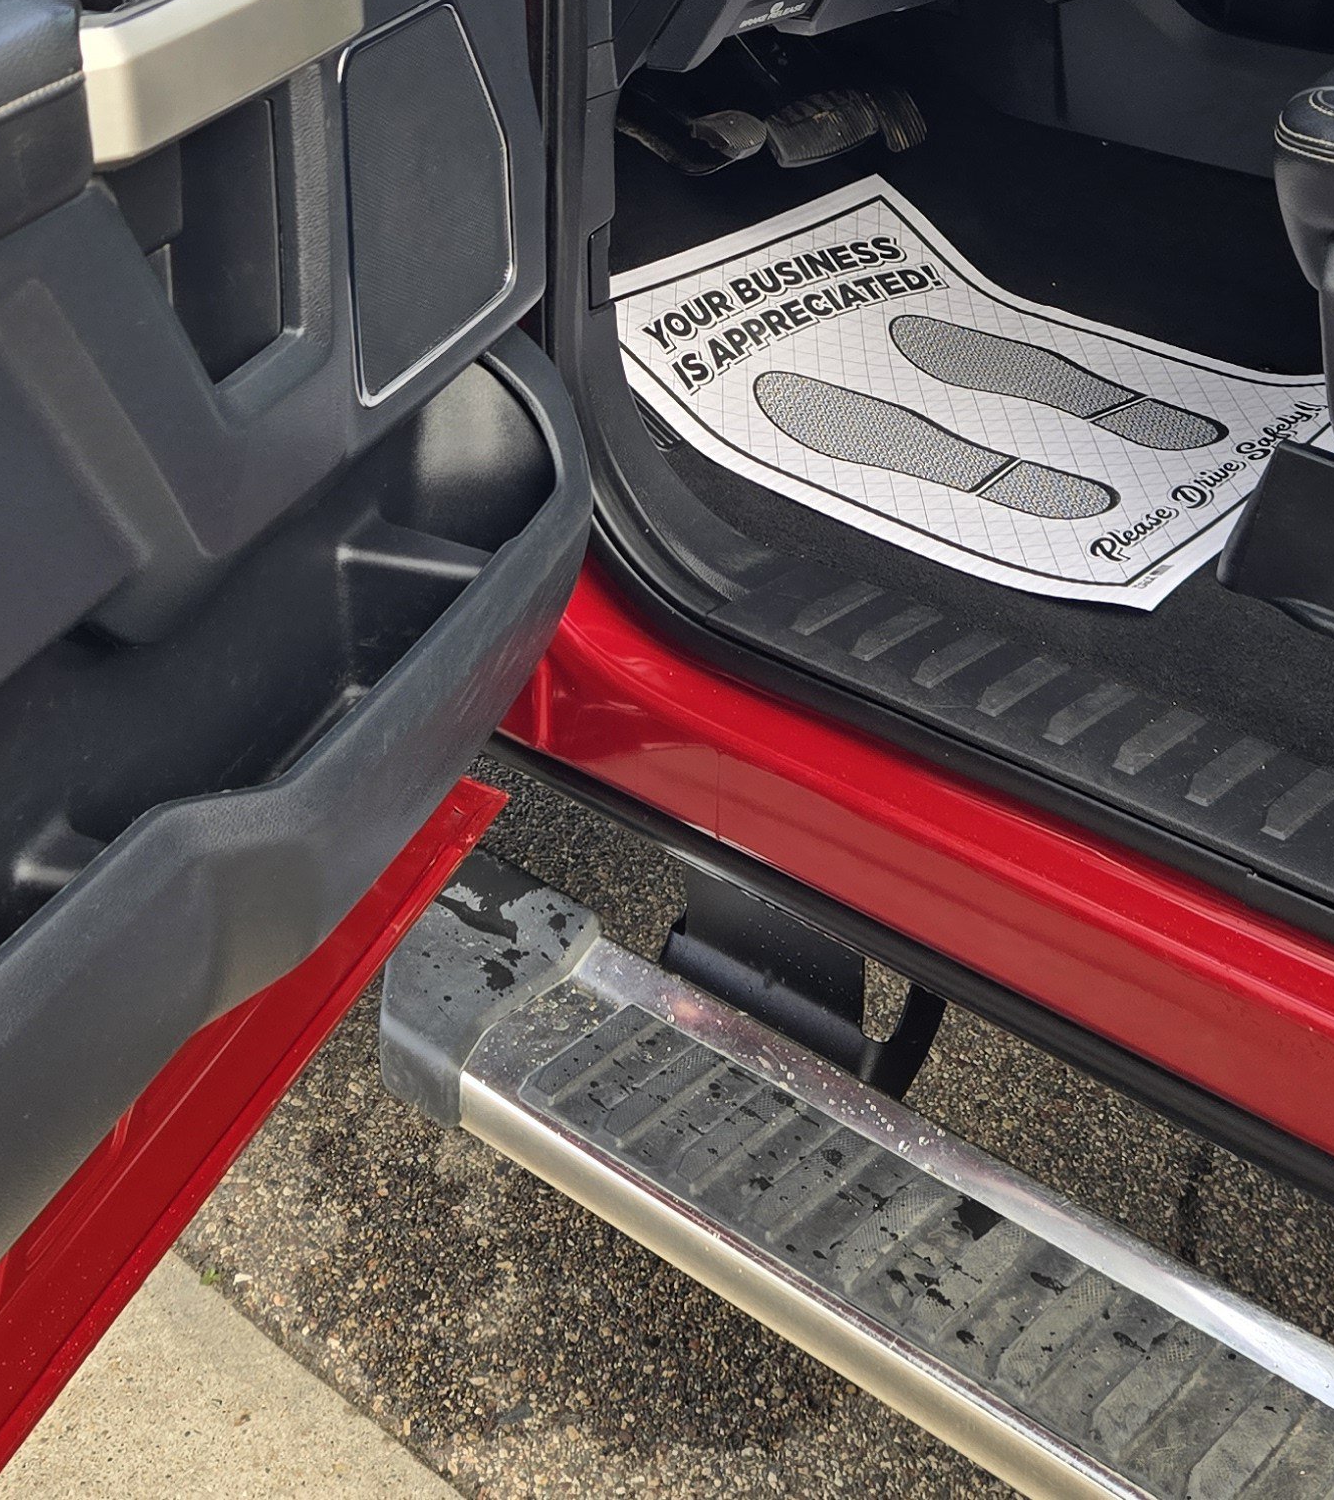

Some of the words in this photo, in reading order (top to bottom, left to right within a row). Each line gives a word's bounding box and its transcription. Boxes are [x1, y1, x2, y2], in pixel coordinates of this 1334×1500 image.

[639, 290, 737, 353] YOUR
[728, 236, 905, 307] BUSINESS
[671, 351, 712, 394] IS
[705, 264, 945, 375] APPRECIATED!
[1088, 505, 1175, 563] Please
[1171, 460, 1242, 510] Drive
